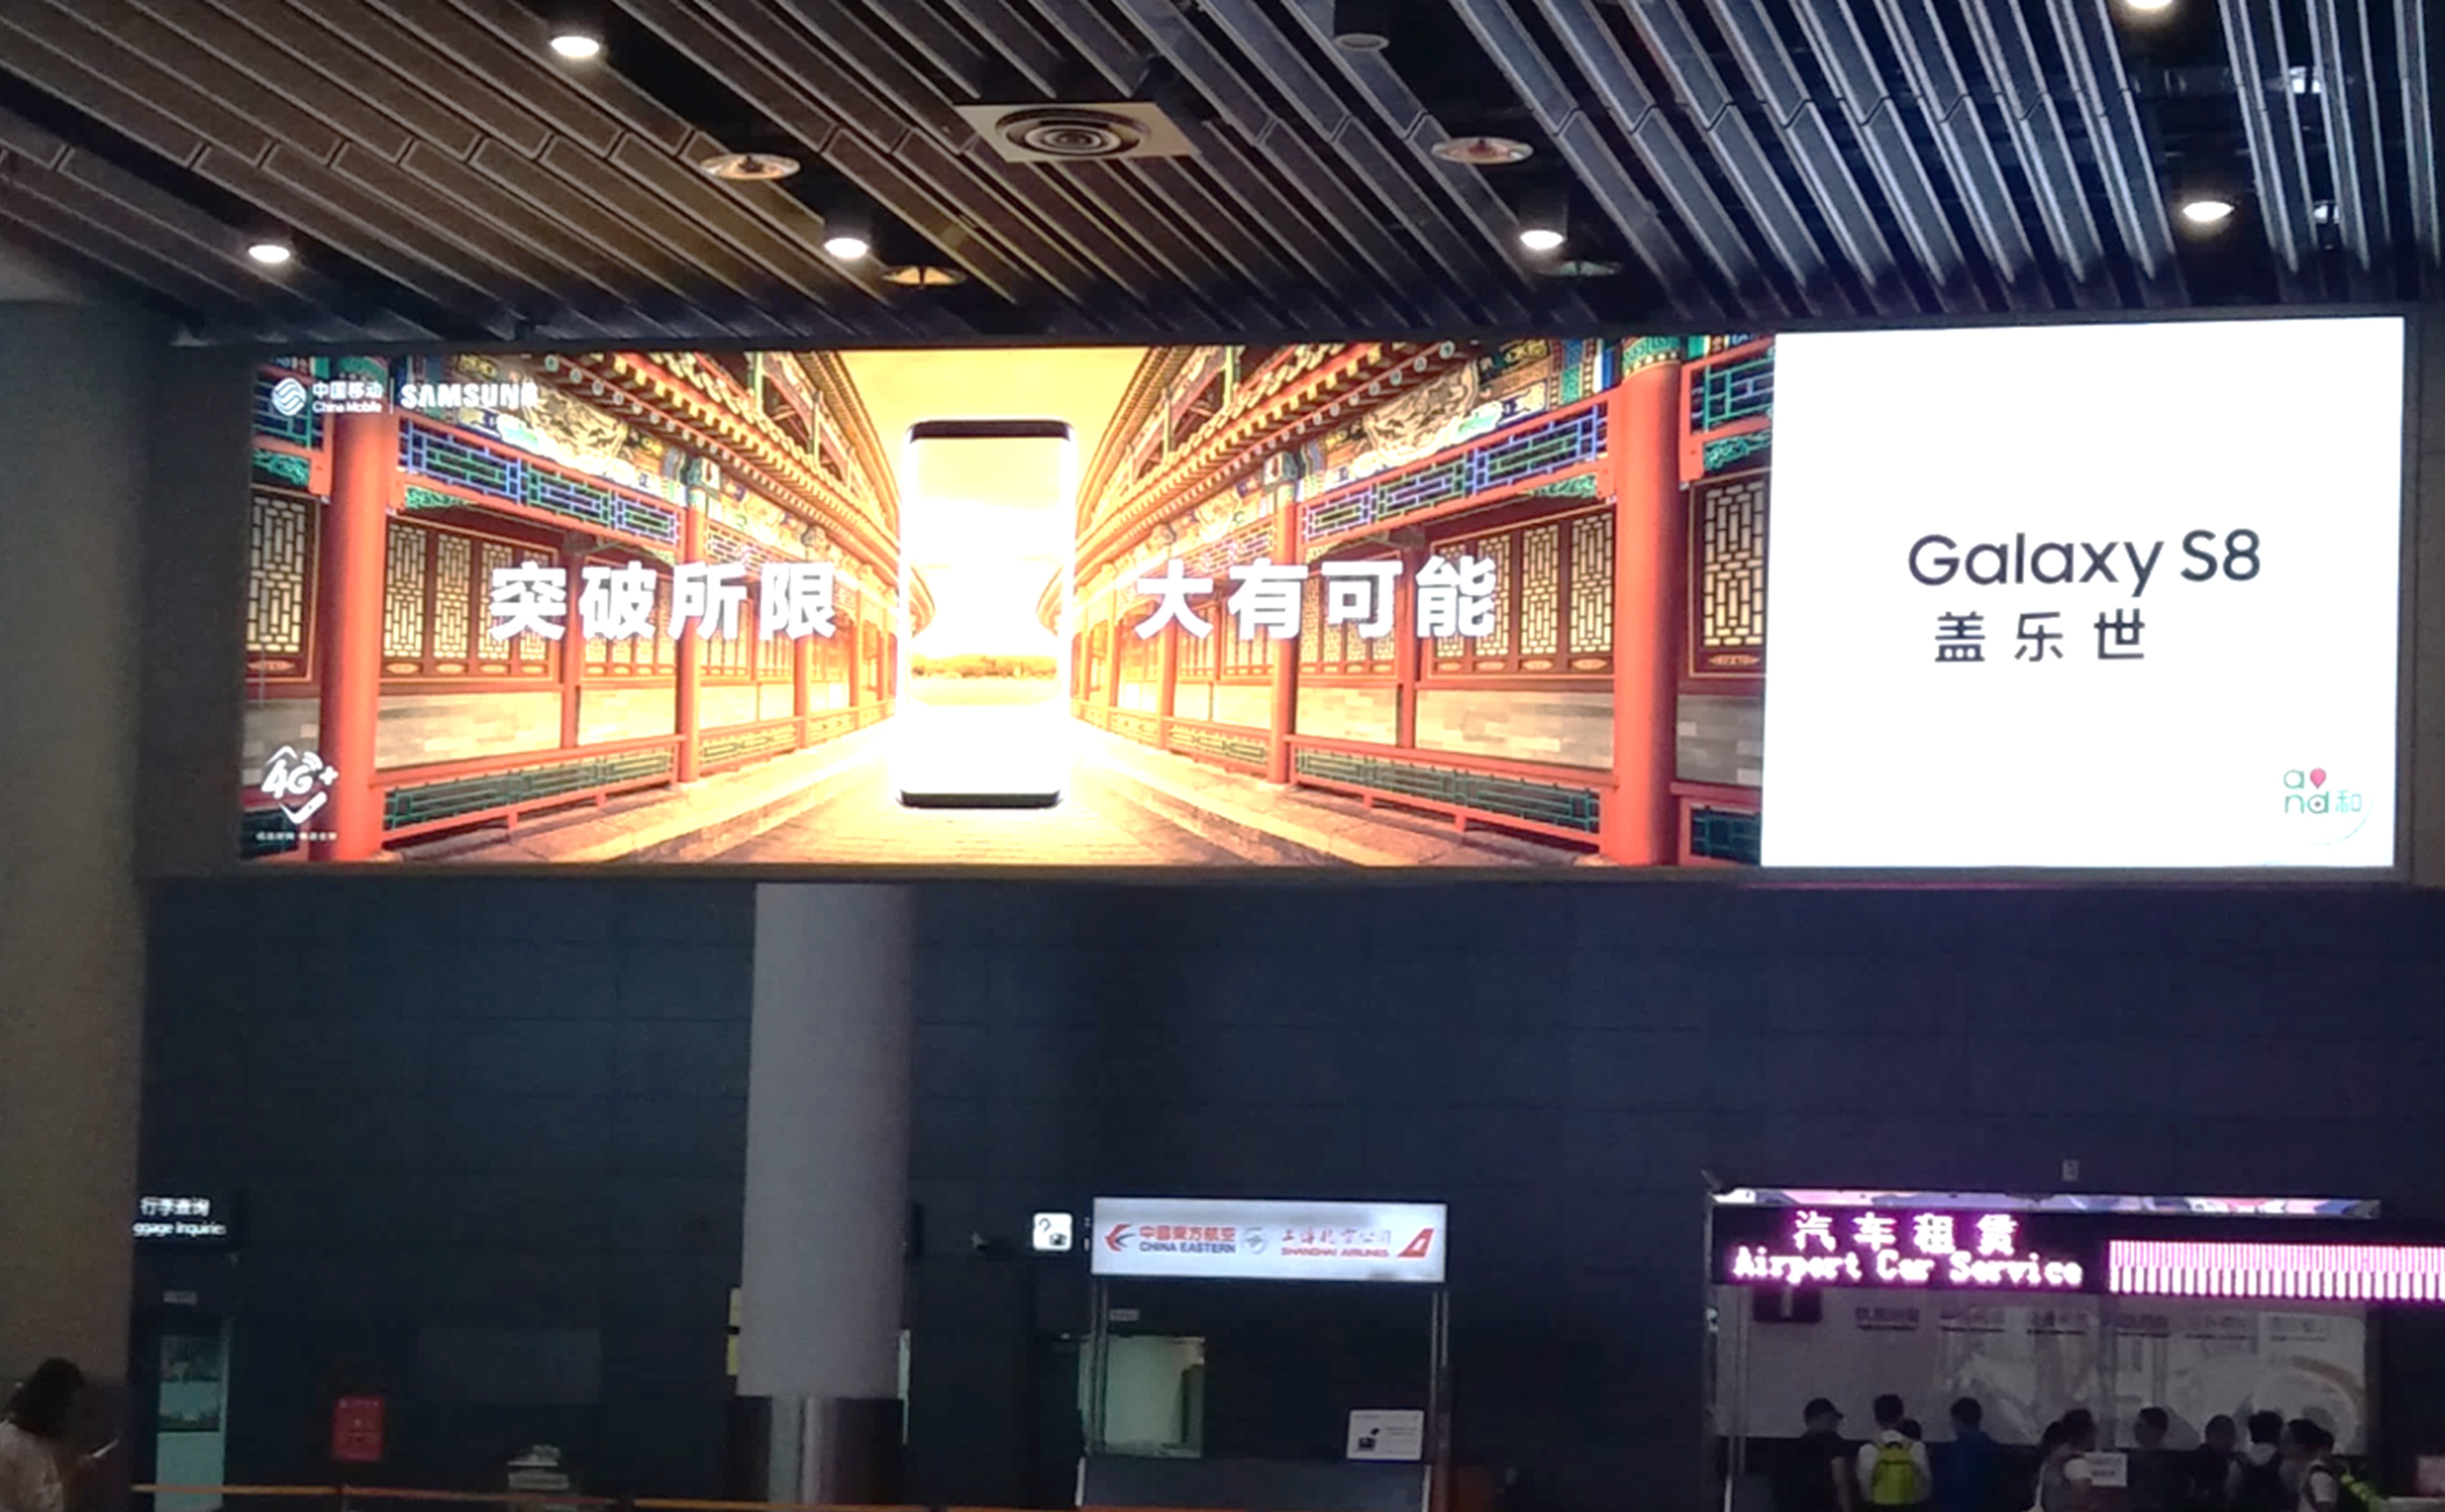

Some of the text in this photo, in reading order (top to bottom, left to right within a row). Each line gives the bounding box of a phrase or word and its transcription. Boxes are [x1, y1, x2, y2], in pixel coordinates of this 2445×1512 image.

[312, 380, 383, 400] 中国移动
[400, 382, 538, 409] SAMSUNG
[312, 401, 382, 413] China Mobile
[1908, 528, 2261, 598] Galaxy S8
[488, 555, 1496, 641] 突破所限 大有可能
[1934, 608, 2146, 663] 盖乐世
[132, 1222, 173, 1237] ggage
[1793, 1210, 2019, 1256] 汽车租赁
[1139, 1241, 1236, 1254] CHINA EASTERN
[1281, 1247, 1389, 1258] SHANGHAI AIRLINES
[1732, 1245, 2083, 1286] Airport Car Service
